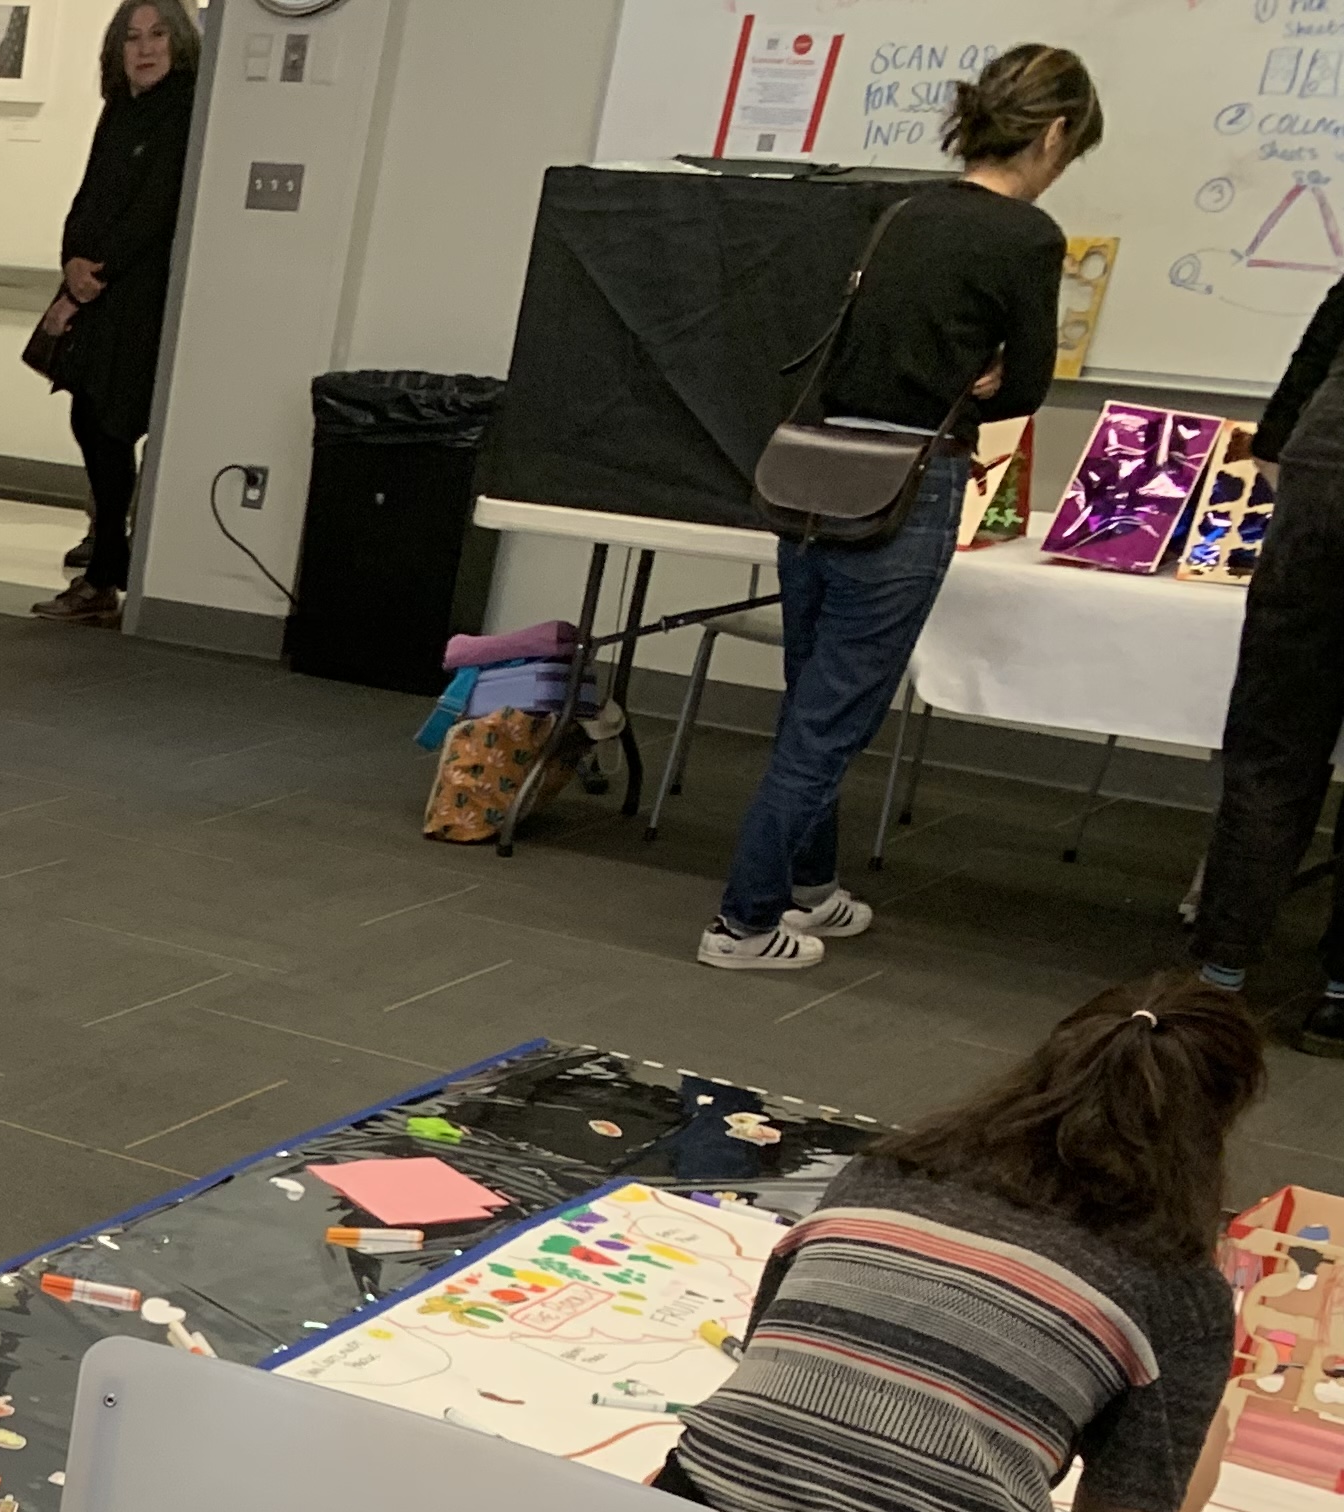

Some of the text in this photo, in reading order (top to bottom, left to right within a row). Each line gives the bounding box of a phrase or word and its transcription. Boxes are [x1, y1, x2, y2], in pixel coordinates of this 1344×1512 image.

[870, 42, 947, 74] SCAN
[864, 82, 900, 115] FOR
[863, 120, 923, 150] INFO
